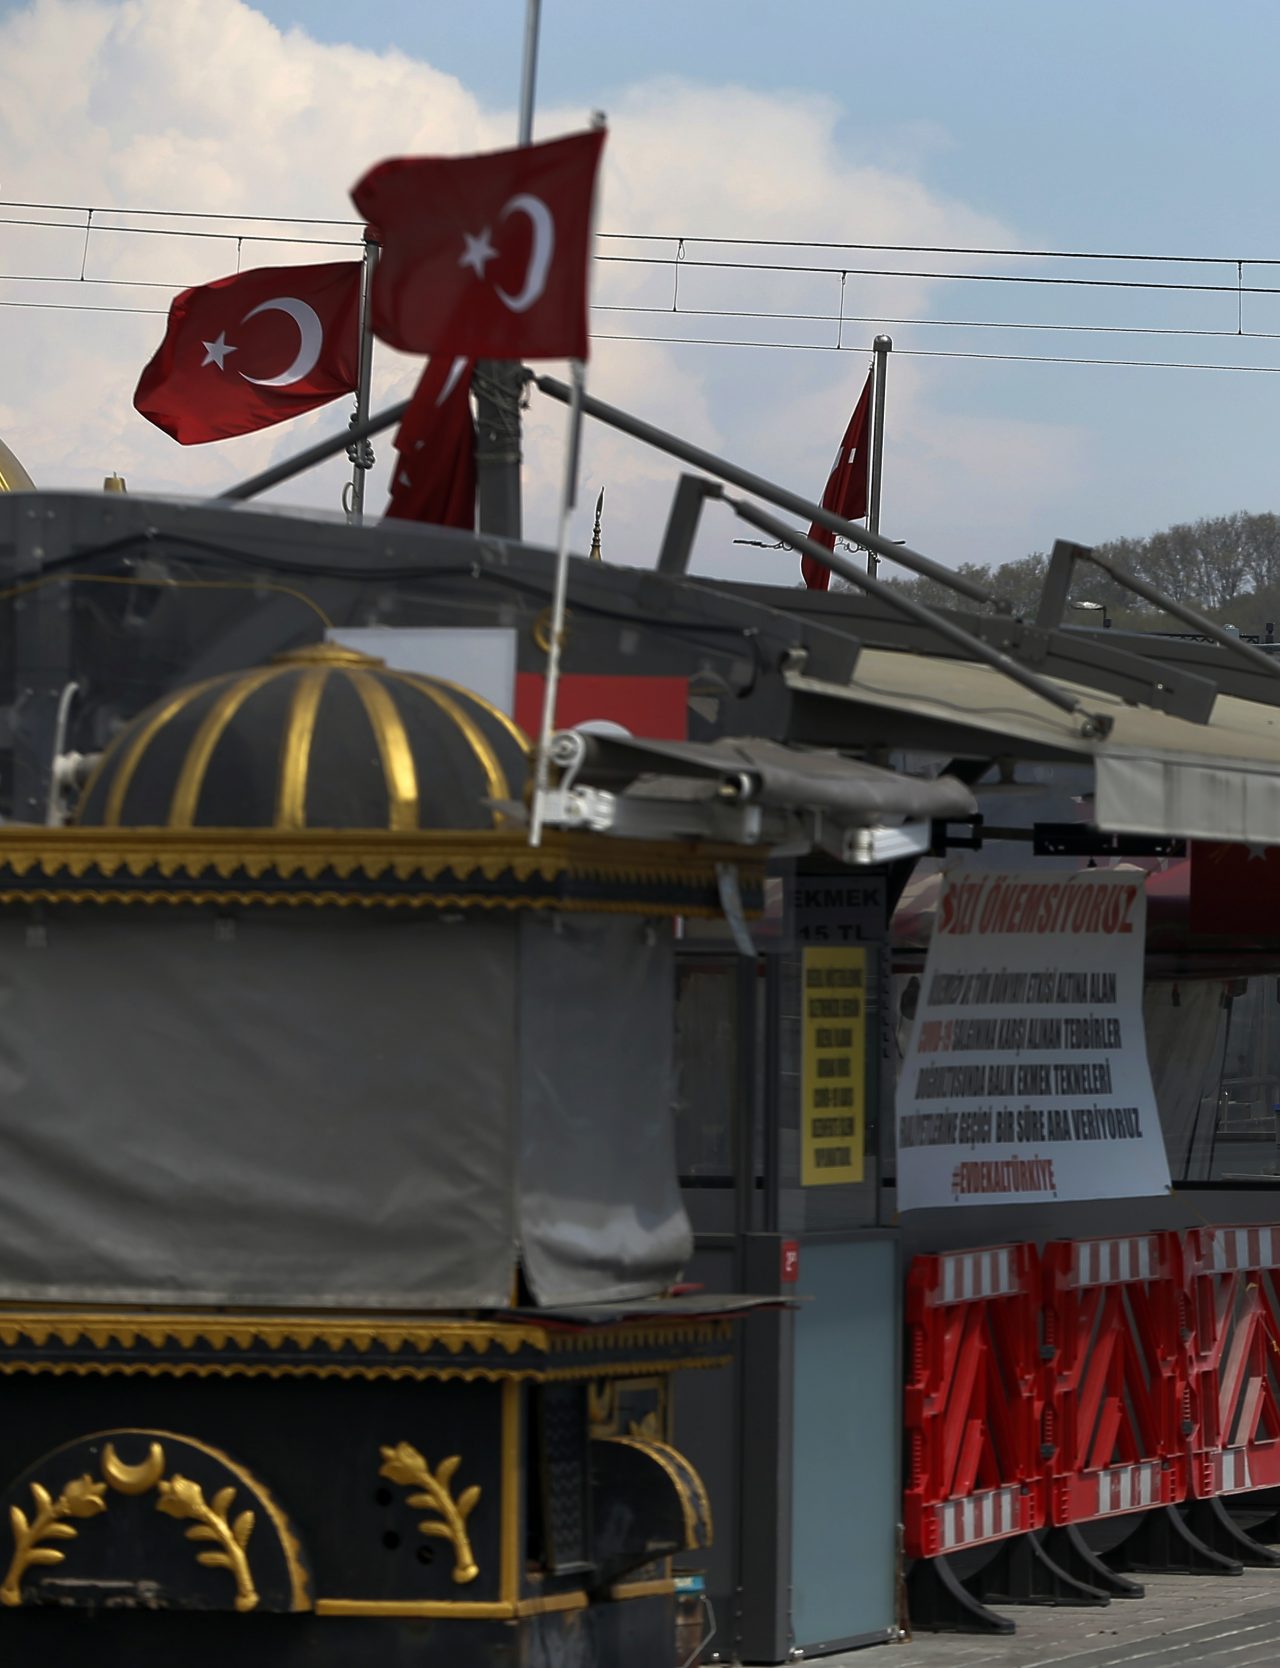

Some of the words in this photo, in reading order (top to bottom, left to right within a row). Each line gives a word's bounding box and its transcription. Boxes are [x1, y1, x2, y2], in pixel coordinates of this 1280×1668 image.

[979, 875, 1138, 934] ÖNEMSİYORUZ
[1063, 1012, 1122, 1049] TEDBİRLER
[1016, 1064, 1053, 1097] EKMEK
[1053, 1058, 1112, 1096] TEKNELERİ
[996, 1106, 1015, 1143] BİR
[1016, 1105, 1046, 1143] SÜRE
[1047, 1110, 1072, 1142] ARA
[1071, 1104, 1143, 1141] VERİYORUZ
[951, 1154, 1056, 1194] #EVDEKALTÜRKİYE
